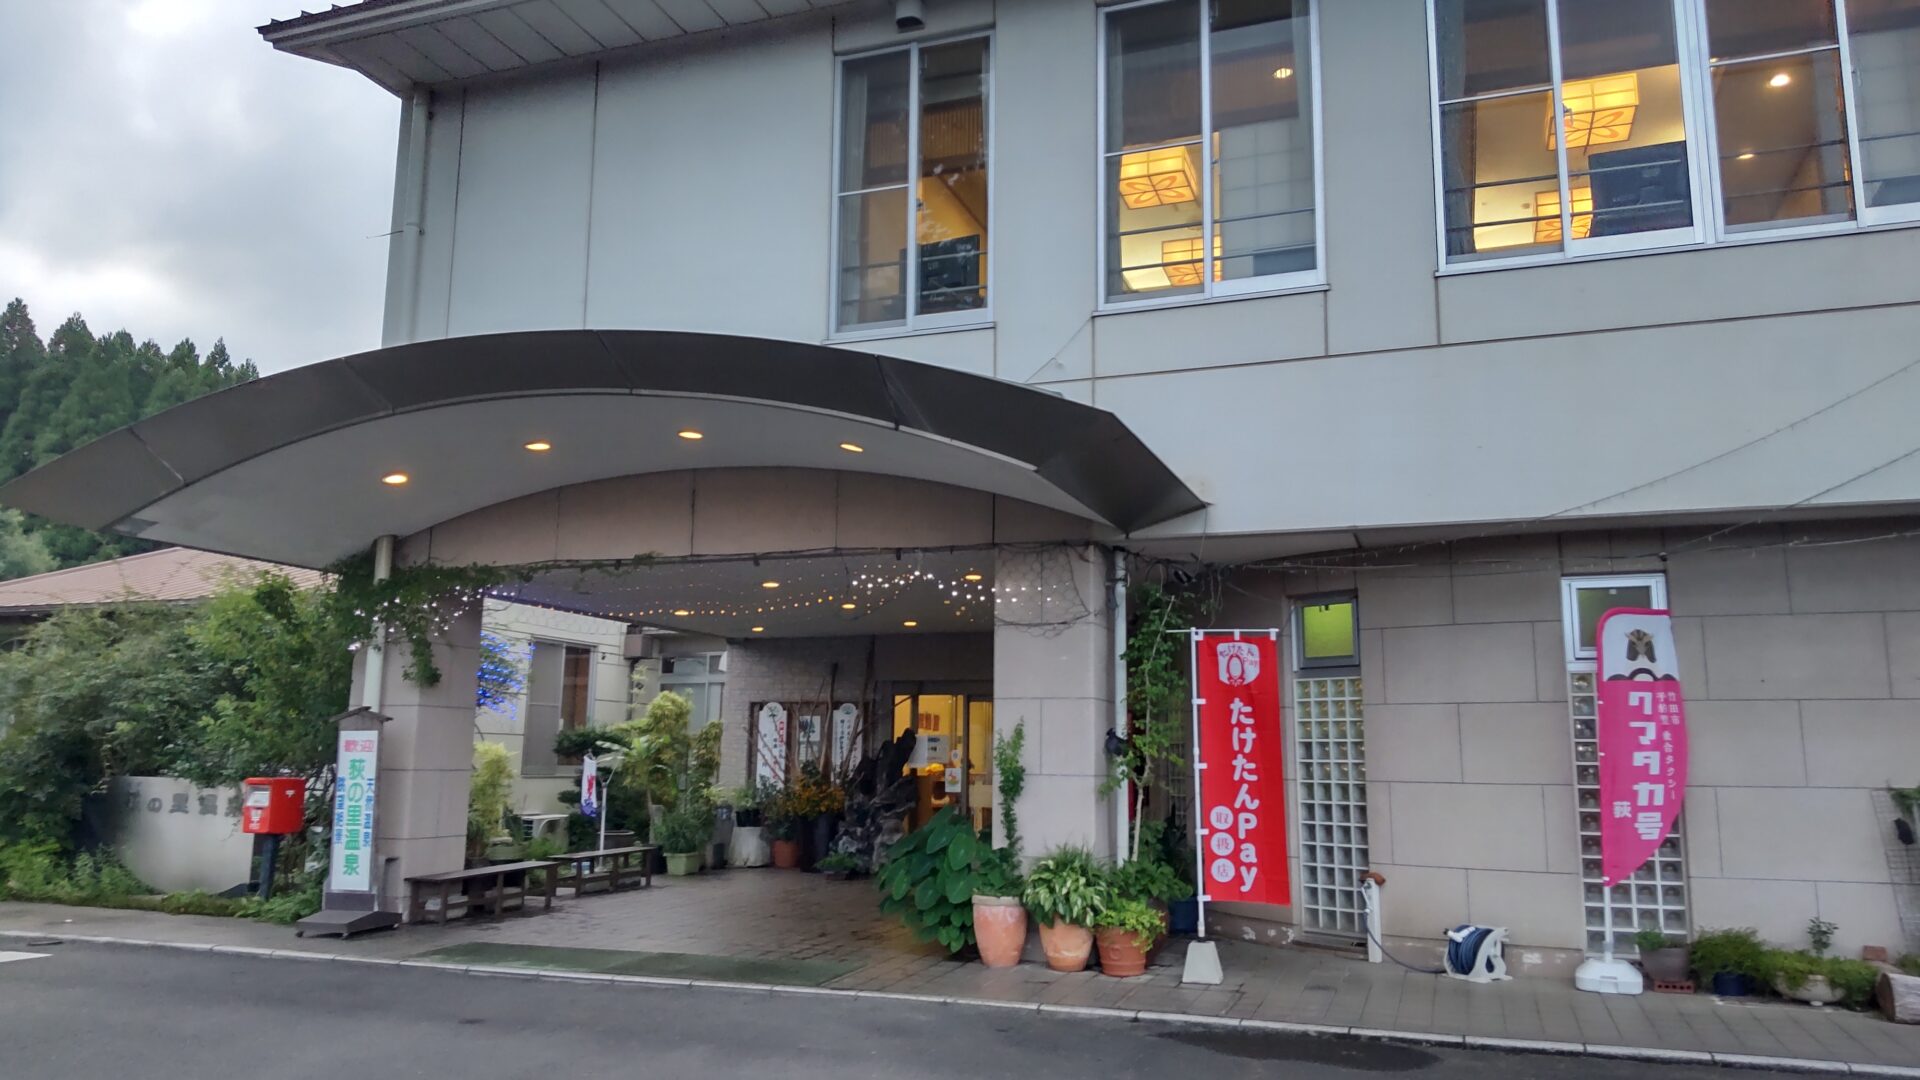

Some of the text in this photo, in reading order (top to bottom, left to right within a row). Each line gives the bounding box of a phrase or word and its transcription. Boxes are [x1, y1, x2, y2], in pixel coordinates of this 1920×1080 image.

[1219, 644, 1255, 658] たけたん
[1243, 656, 1258, 668] Pay
[1667, 691, 1680, 725] 竹田市
[344, 739, 375, 753] 歓迎
[1628, 691, 1665, 840] クマタカ号
[1229, 697, 1260, 893] たけたんPay
[1613, 801, 1632, 819] 荻
[343, 758, 366, 876] 荻の里温泉
[1213, 809, 1232, 879] 取扱店
